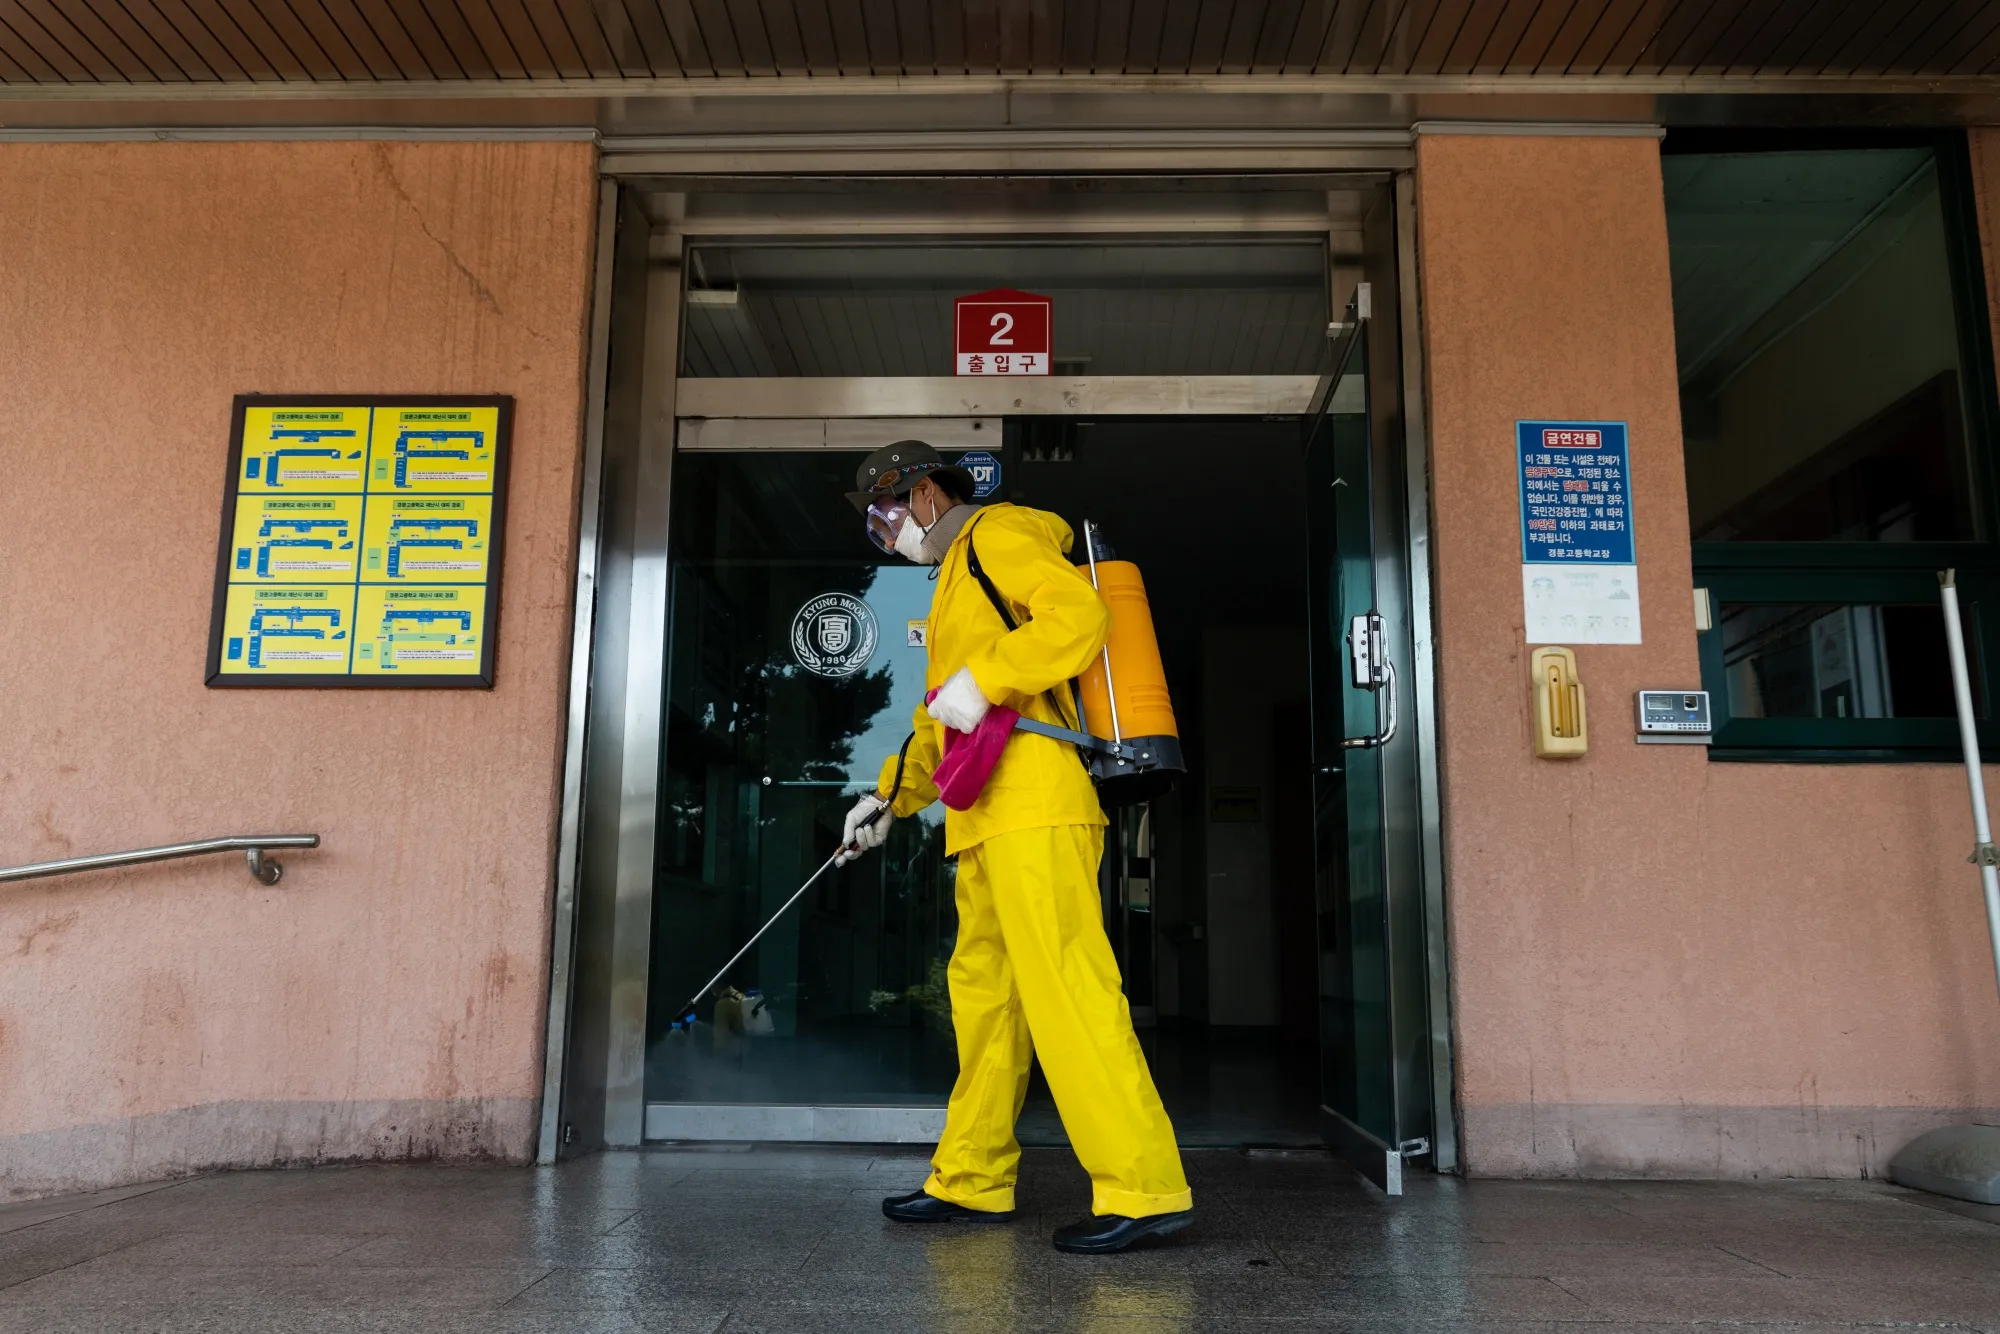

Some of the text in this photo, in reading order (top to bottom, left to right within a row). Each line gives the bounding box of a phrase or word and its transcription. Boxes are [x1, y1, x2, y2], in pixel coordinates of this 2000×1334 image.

[989, 312, 1014, 345] 2
[1547, 432, 1597, 444] 금연건물
[1525, 454, 1620, 465] 이 건물 또는 시설은 전체가
[1525, 467, 1620, 478] 금연구역으로, 지정된 장소
[1527, 480, 1621, 491] 외에서는 담배를 피울 수
[1528, 494, 1624, 505] 없습니다. 이를 위반할 경우,
[1595, 508, 1603, 518] 에
[1607, 508, 1623, 518] 따라
[1528, 519, 1624, 531] 10만원 이하의 과태료가
[1530, 533, 1574, 543] 부과됩니다.
[1548, 549, 1610, 558] 경문고등학교장
[803, 598, 867, 620] KYUNG MOON
[822, 655, 846, 665] 1980
